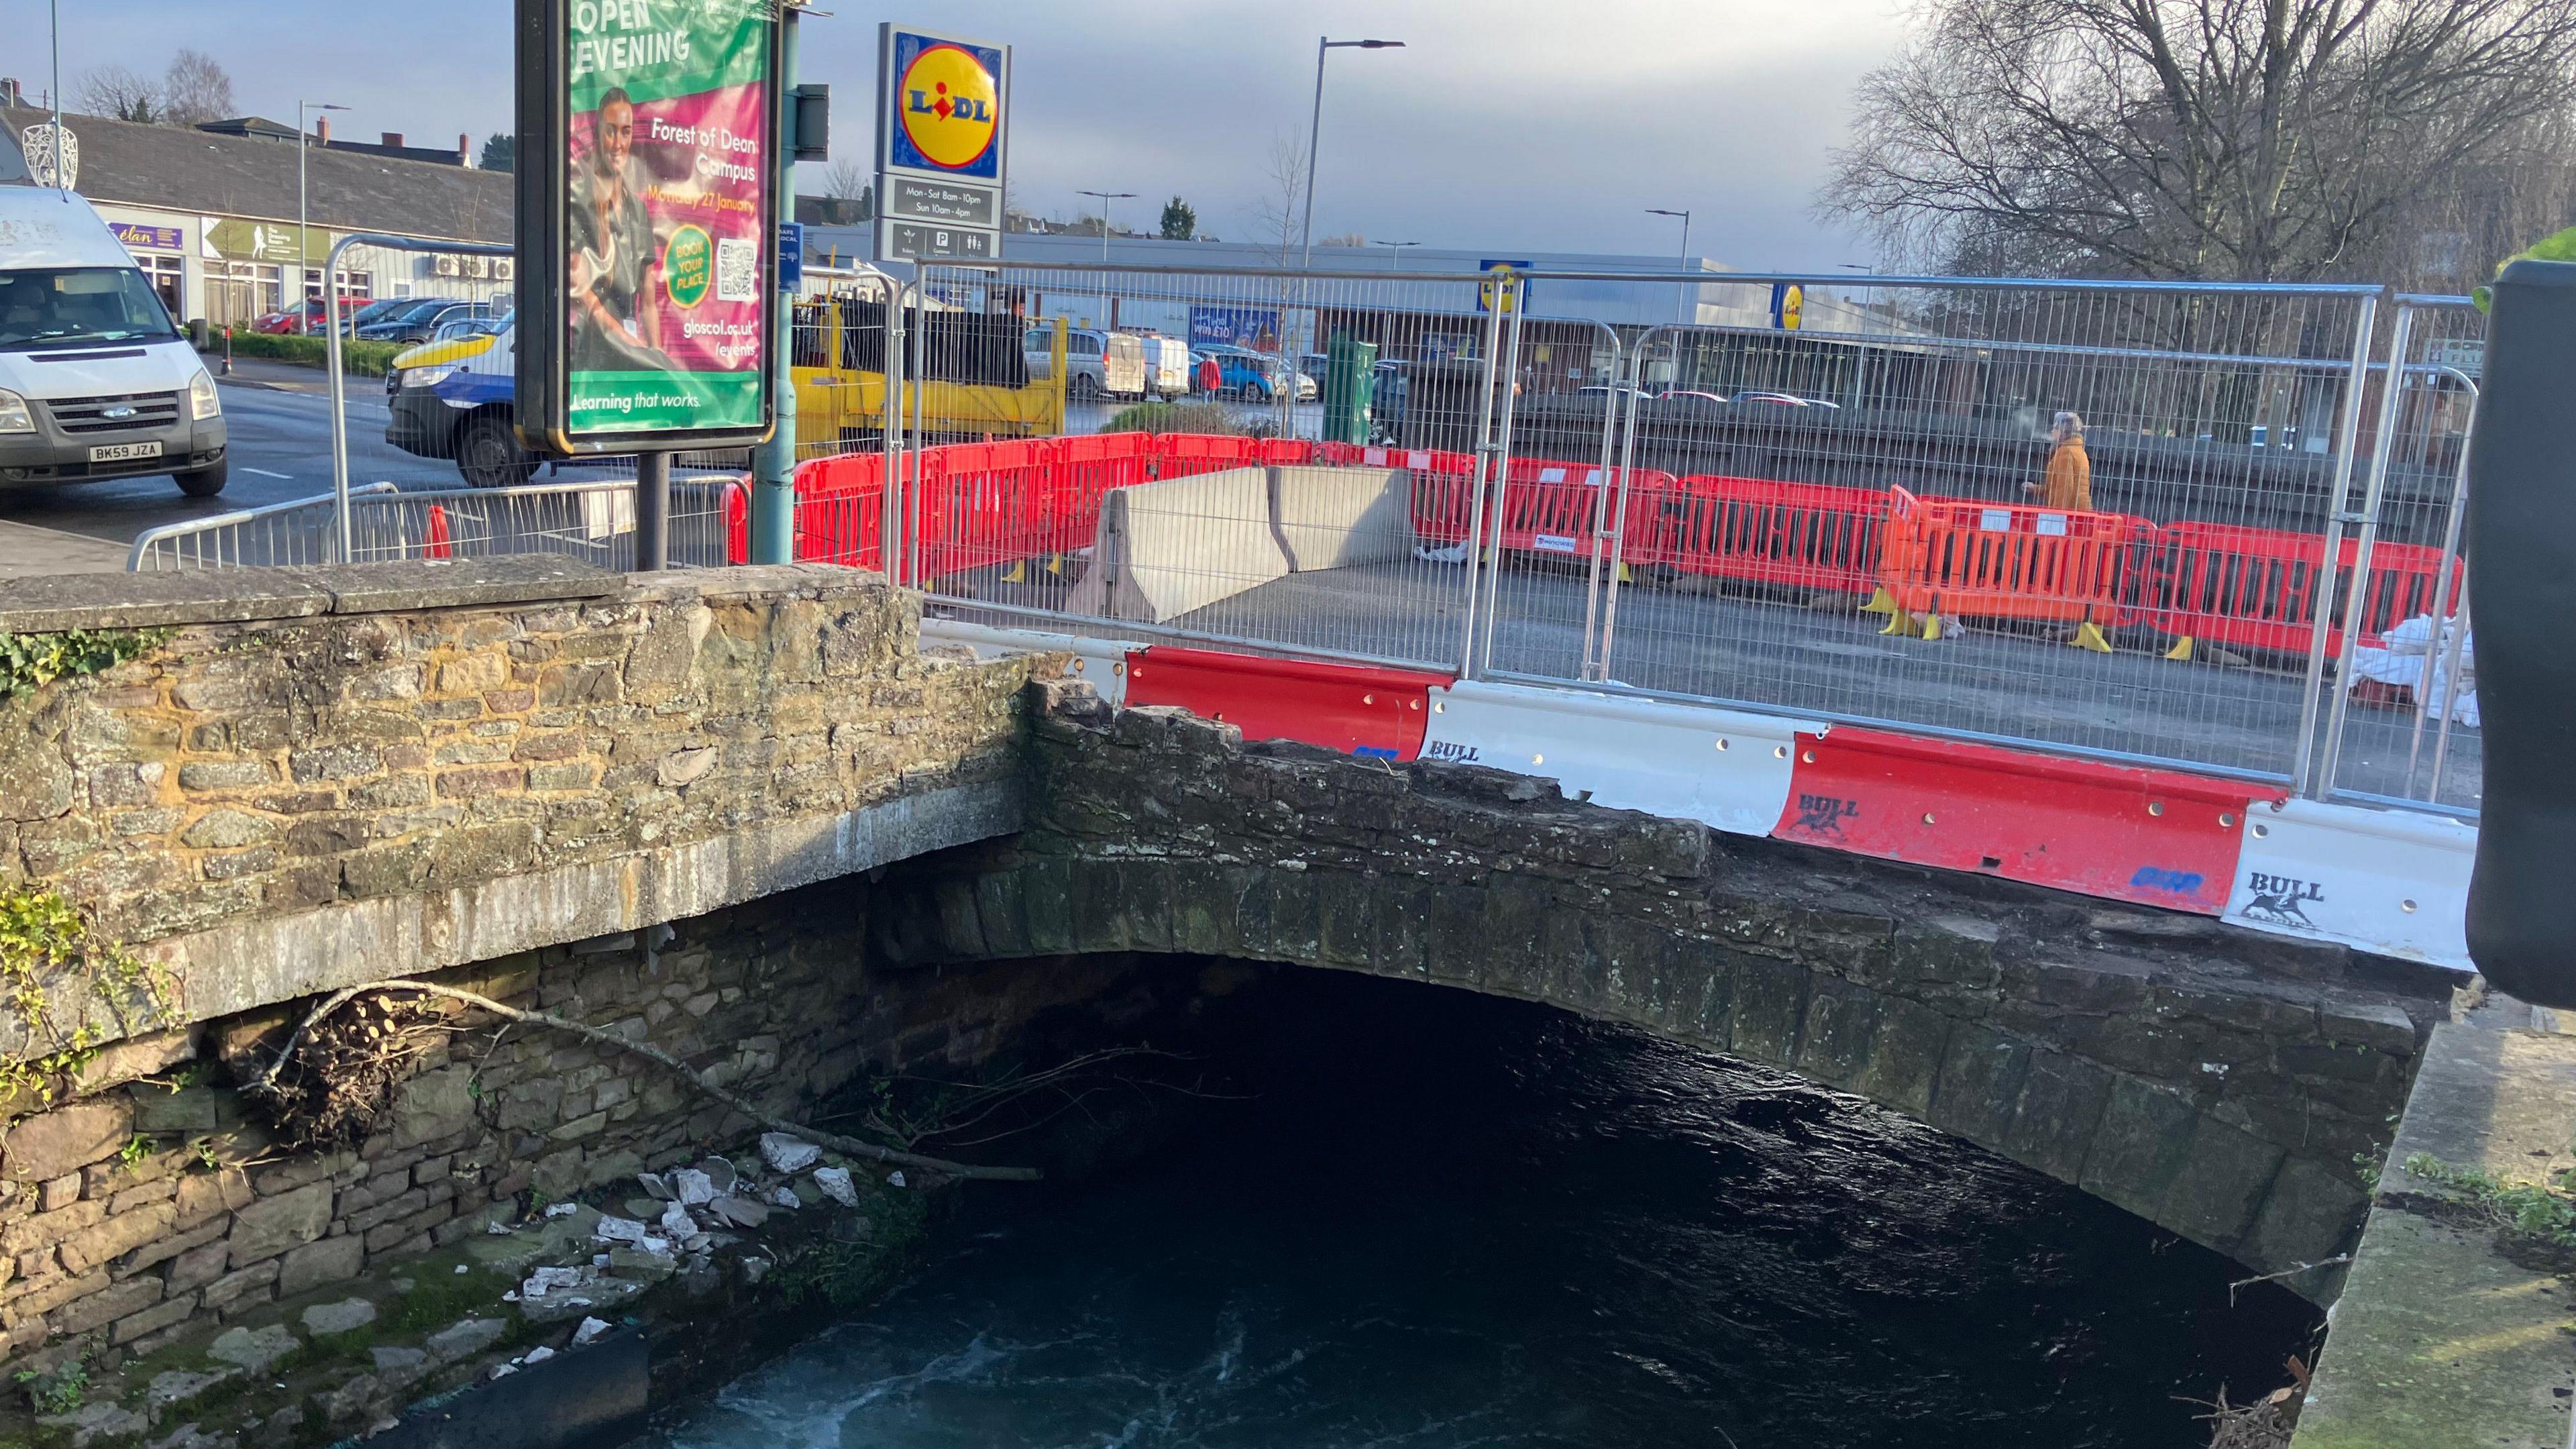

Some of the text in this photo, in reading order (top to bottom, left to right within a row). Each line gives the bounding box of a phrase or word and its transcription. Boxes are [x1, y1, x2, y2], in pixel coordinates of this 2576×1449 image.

[576, 0, 651, 34] OPEN
[576, 29, 690, 73] EVENING
[651, 117, 756, 154] Forest of Dean
[696, 153, 755, 185] Campus
[648, 184, 755, 216] Monday 27 January
[916, 202, 930, 212] Sun
[676, 241, 704, 258] BOOK
[678, 257, 704, 274] YOUR
[676, 272, 704, 290] PLACE
[684, 318, 753, 339] gloscol.ac.uk
[716, 341, 756, 357] /events
[570, 391, 702, 414] Learning that works.
[96, 444, 156, 460] BK59 JZA
[1428, 740, 1480, 762] BULL
[1799, 794, 1860, 817] BULL
[2248, 871, 2325, 902] BULL
